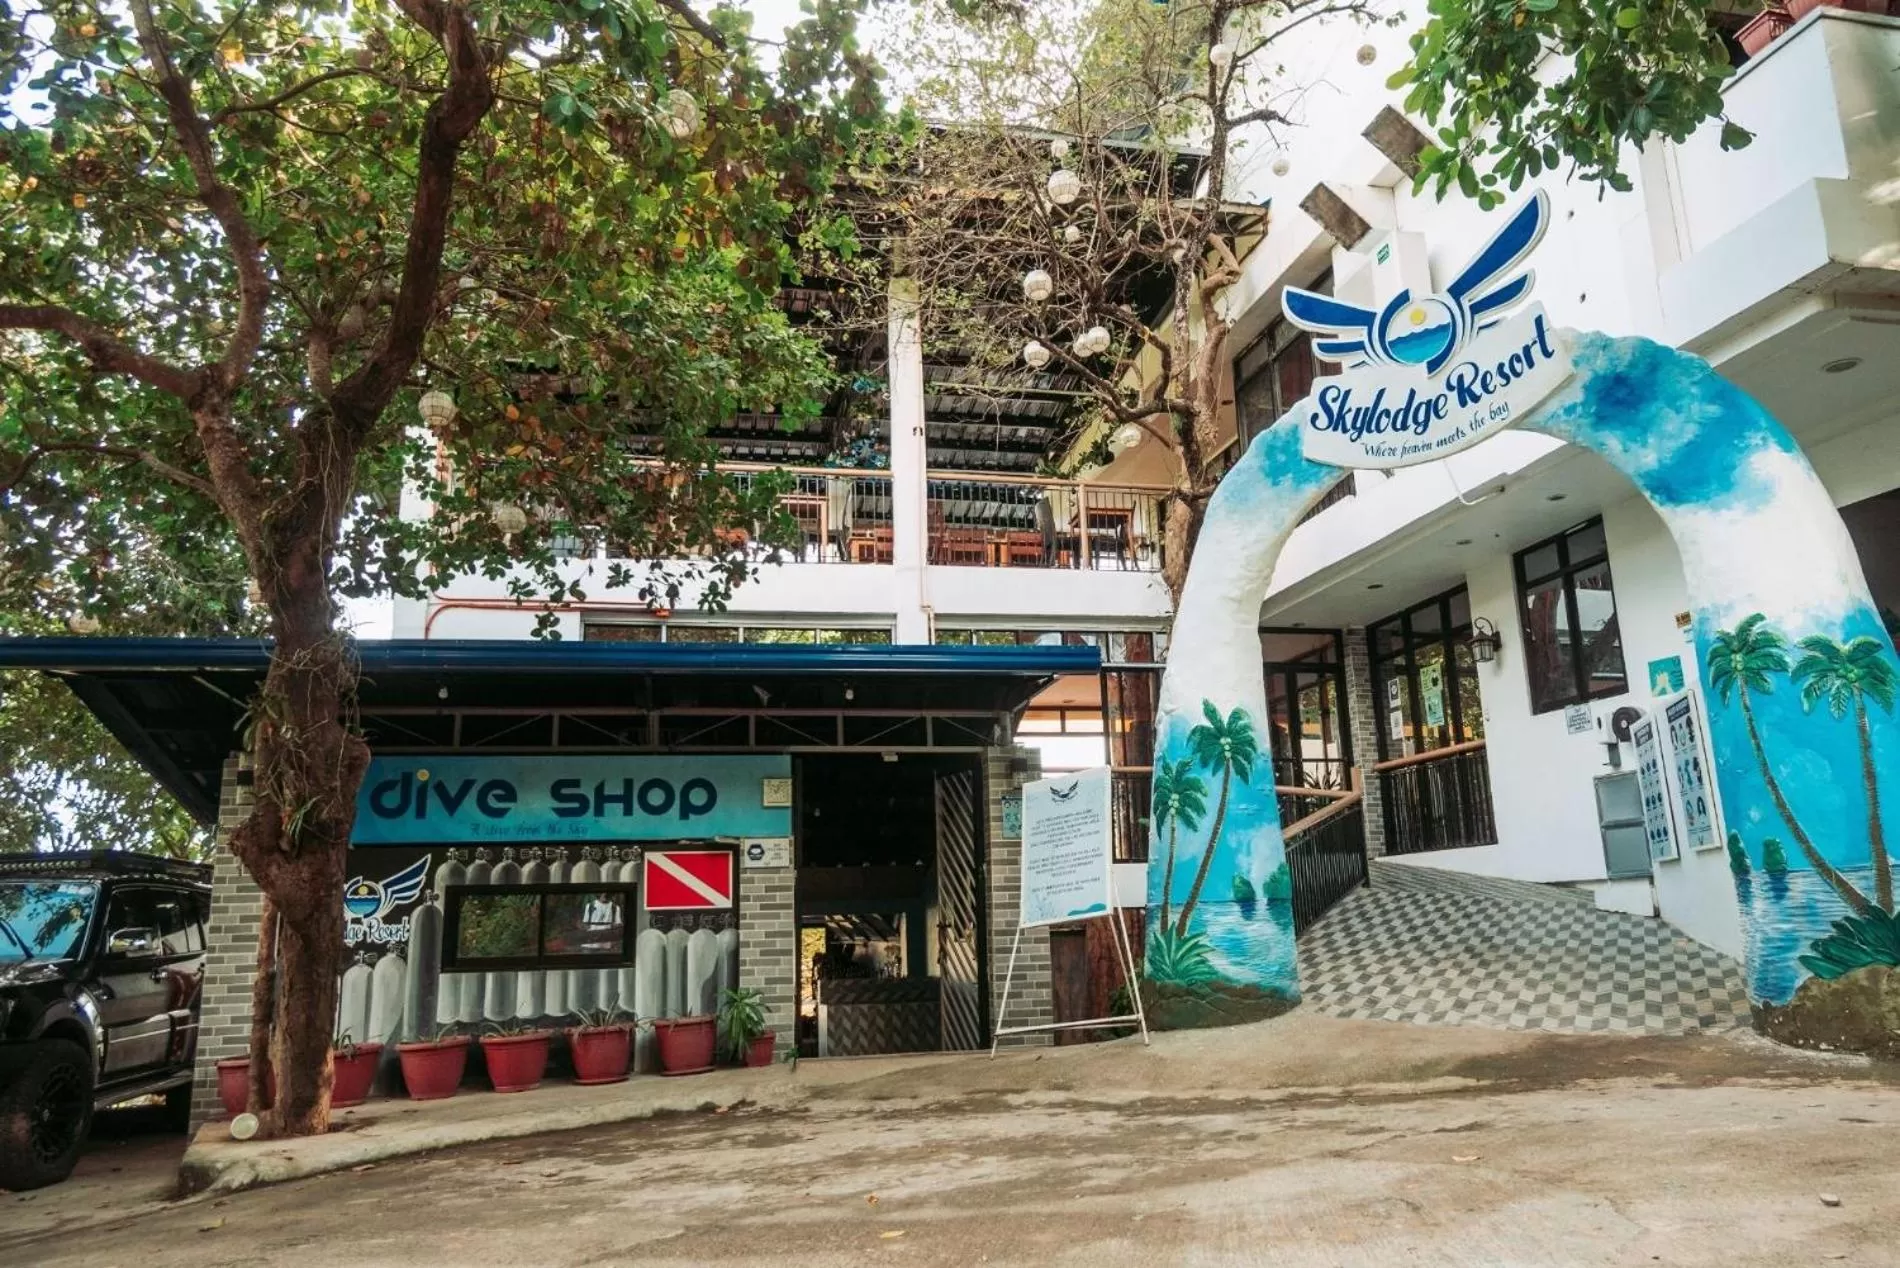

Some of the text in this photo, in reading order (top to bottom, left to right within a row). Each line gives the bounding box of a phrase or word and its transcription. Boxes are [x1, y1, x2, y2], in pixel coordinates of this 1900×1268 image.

[1311, 314, 1555, 442] Skylodge Resort
[1361, 400, 1510, 459] Where heaven meets the bay
[370, 768, 518, 820] dive
[364, 916, 410, 943] Resort
